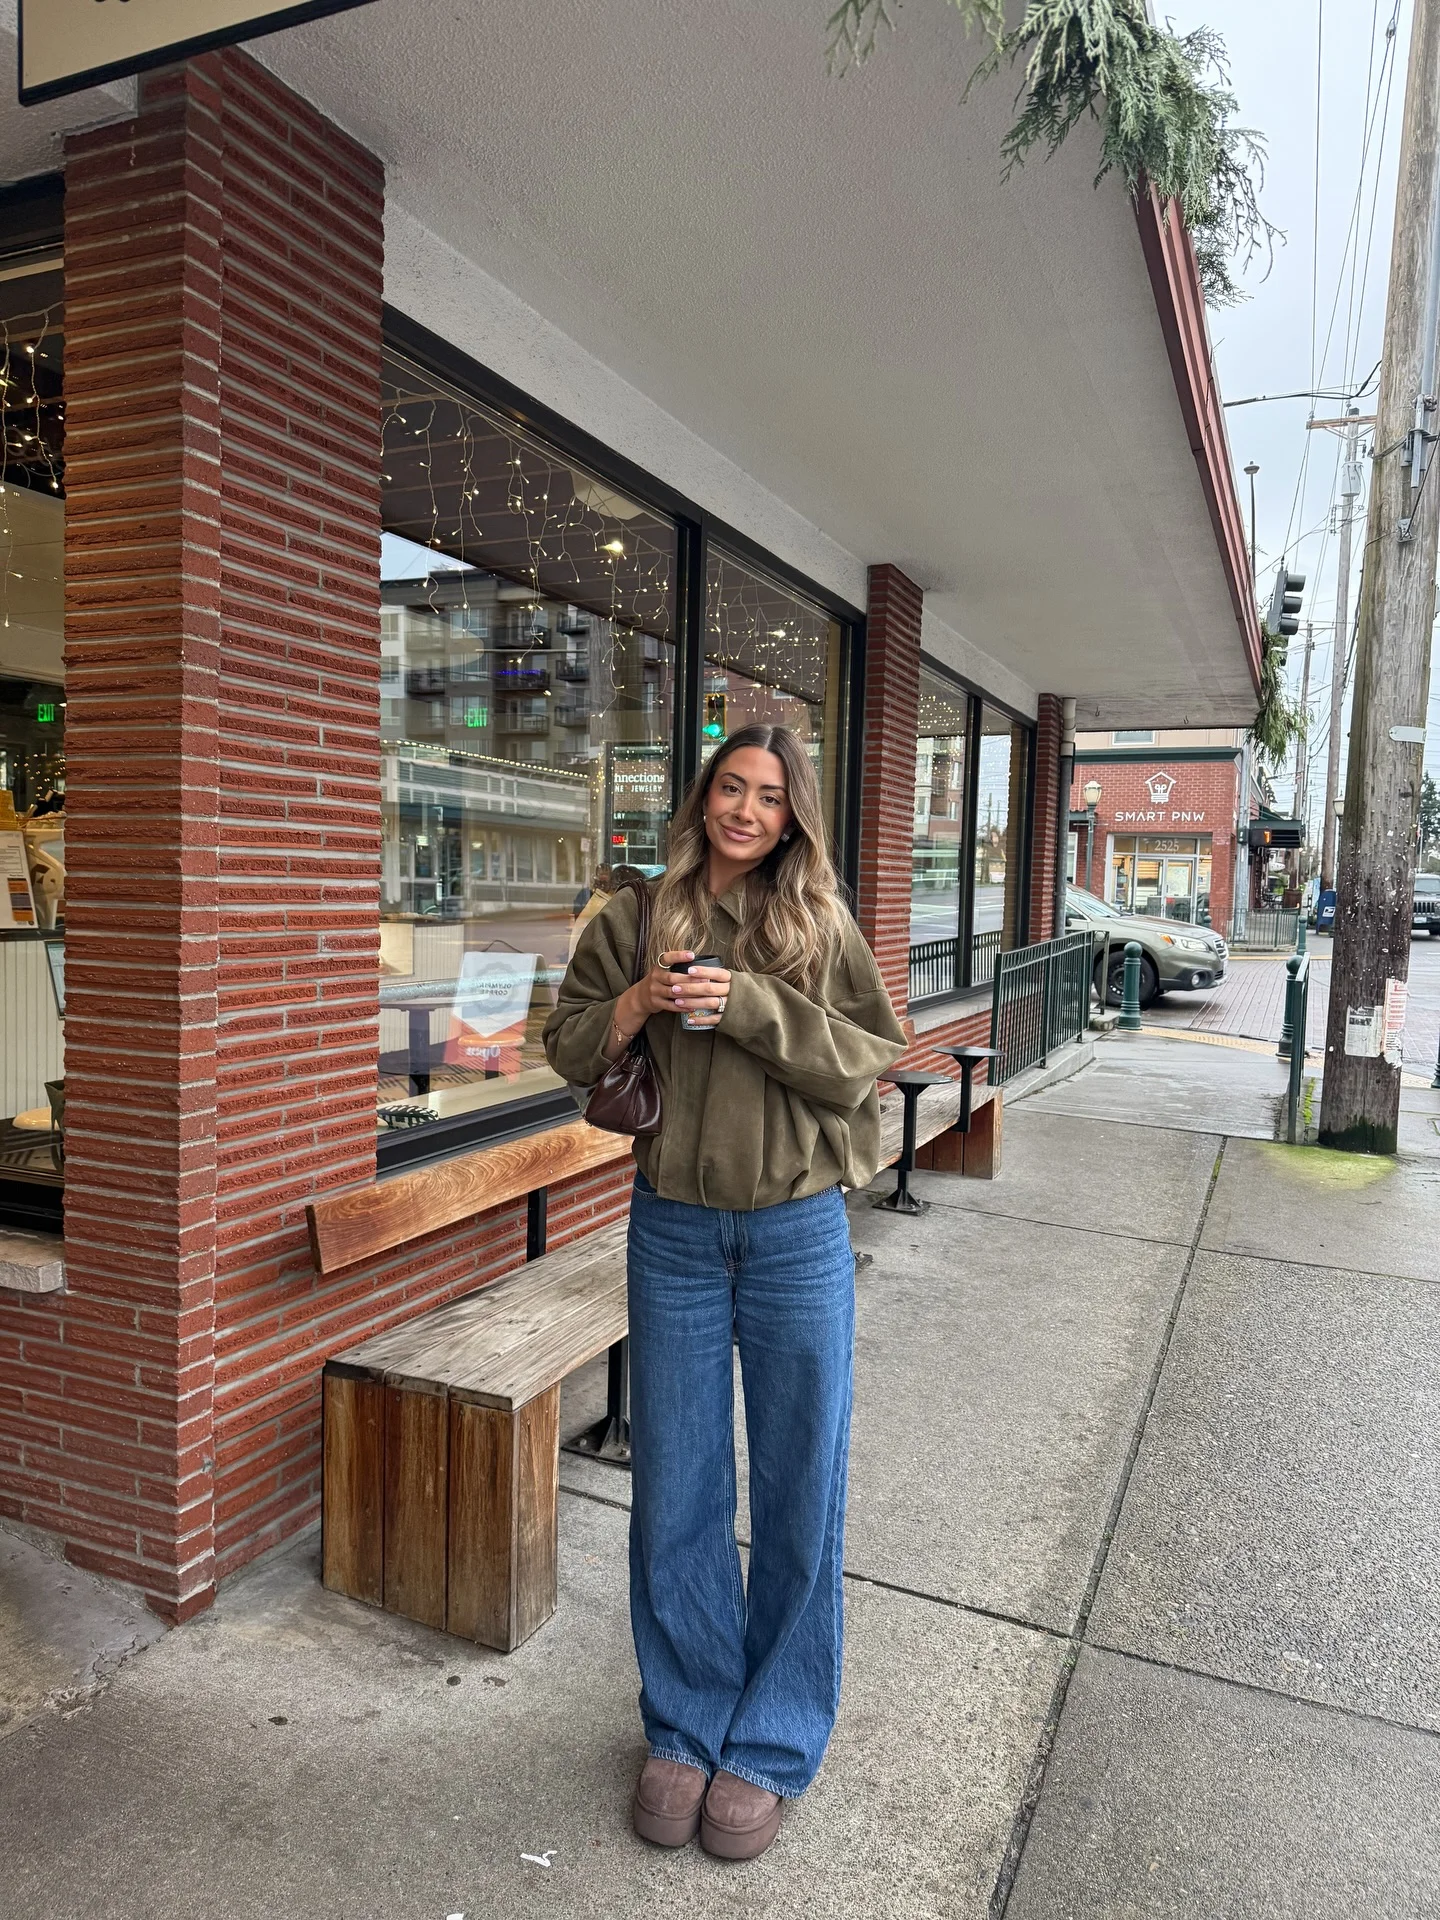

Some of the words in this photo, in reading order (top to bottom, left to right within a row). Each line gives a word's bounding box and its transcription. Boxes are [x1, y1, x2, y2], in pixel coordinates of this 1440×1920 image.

[38, 704, 55, 722] EXIT
[467, 707, 488, 727] EXIT
[631, 785, 662, 793] JEWELRY
[1115, 811, 1166, 822] SMART
[1171, 811, 1205, 822] PNW
[1154, 839, 1180, 851] 2525
